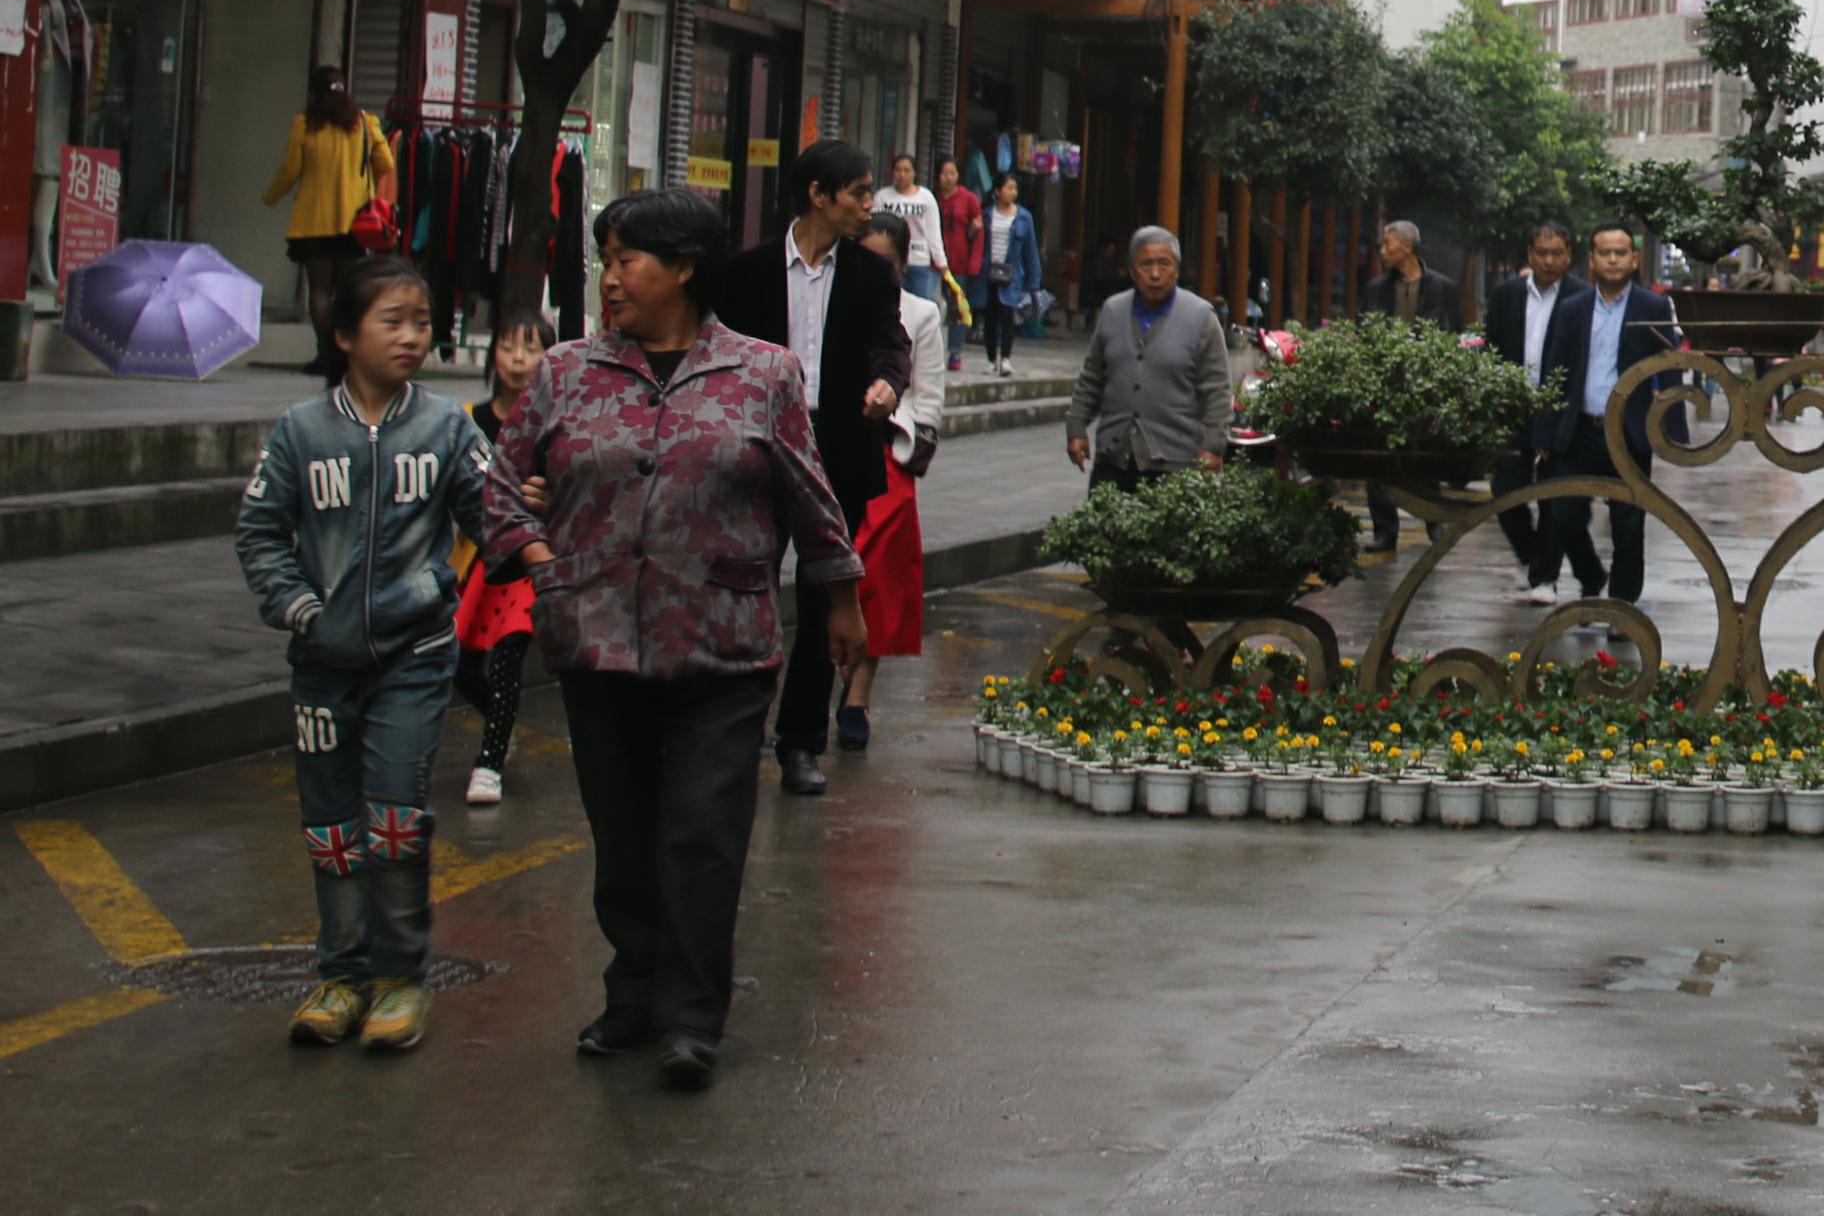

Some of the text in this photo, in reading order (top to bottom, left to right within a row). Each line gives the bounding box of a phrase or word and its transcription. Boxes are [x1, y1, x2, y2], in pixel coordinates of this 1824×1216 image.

[67, 149, 121, 213] 招聘
[309, 456, 351, 510] ON
[394, 452, 439, 503] DO
